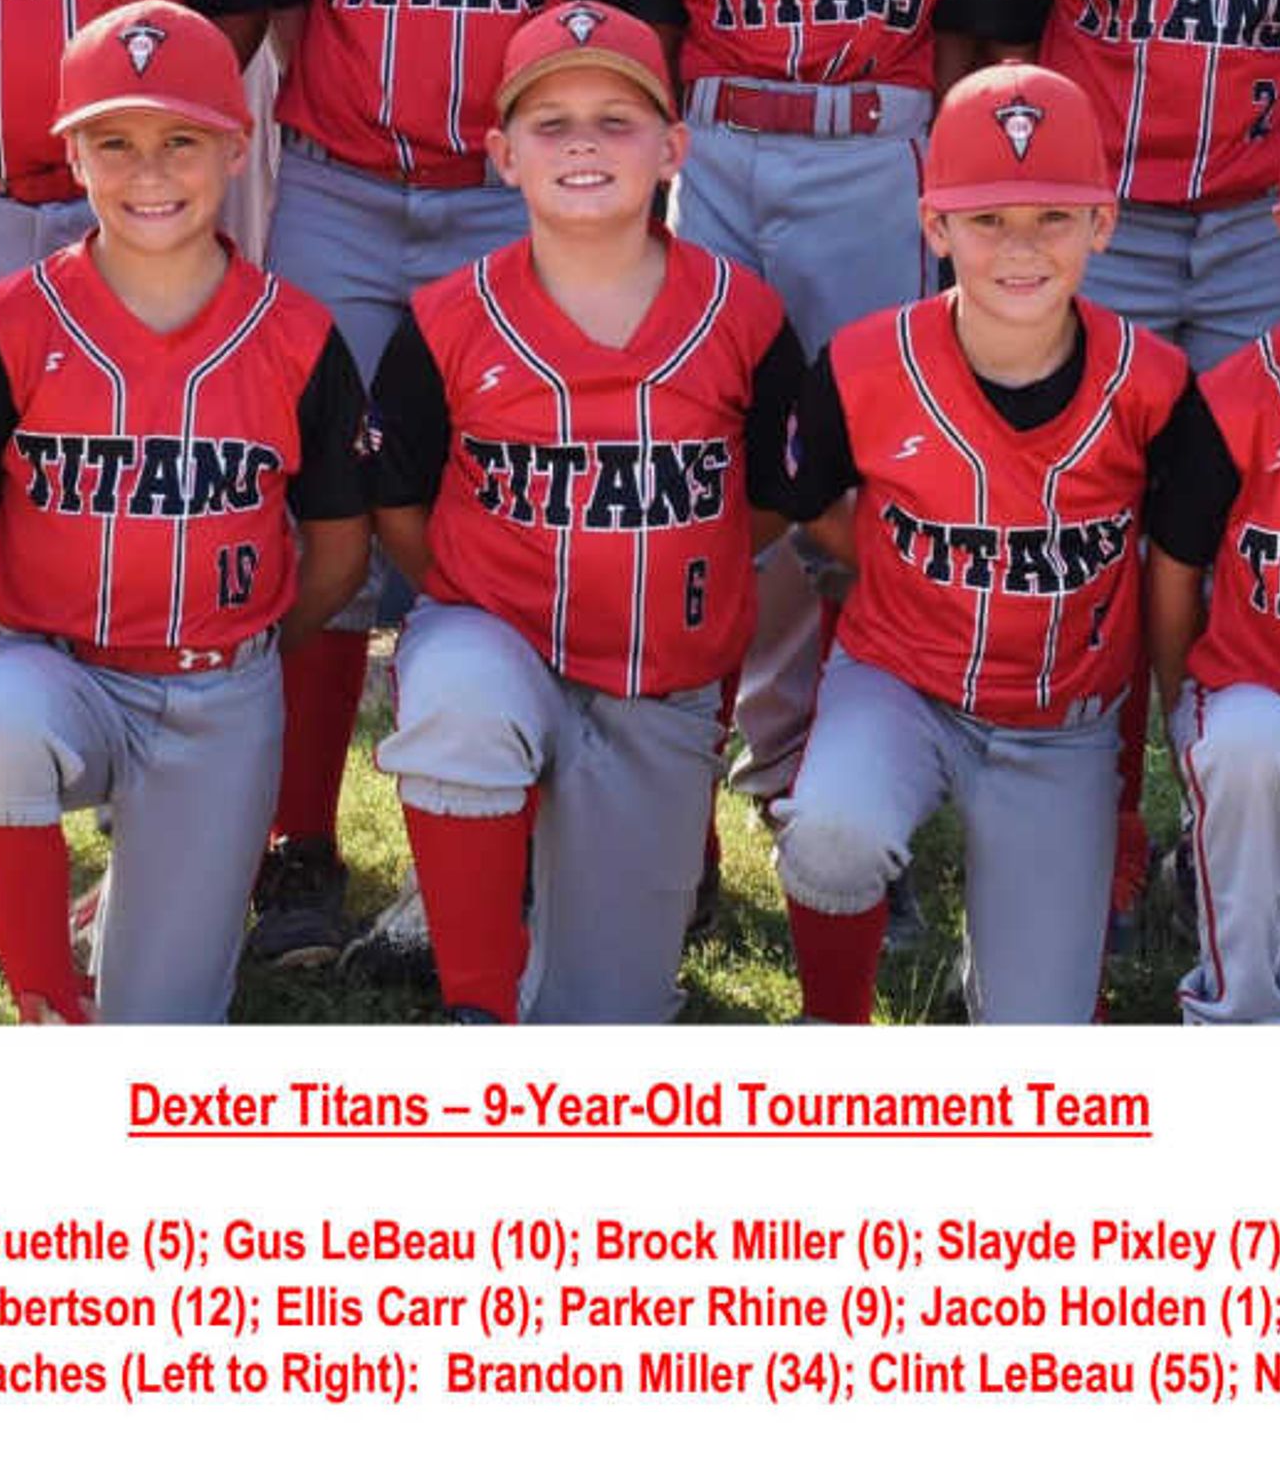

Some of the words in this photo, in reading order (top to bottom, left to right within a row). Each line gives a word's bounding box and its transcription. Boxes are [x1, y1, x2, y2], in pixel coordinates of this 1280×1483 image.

[1248, 78, 1280, 143] 2
[460, 432, 730, 532] TITANS
[683, 556, 709, 631] 6
